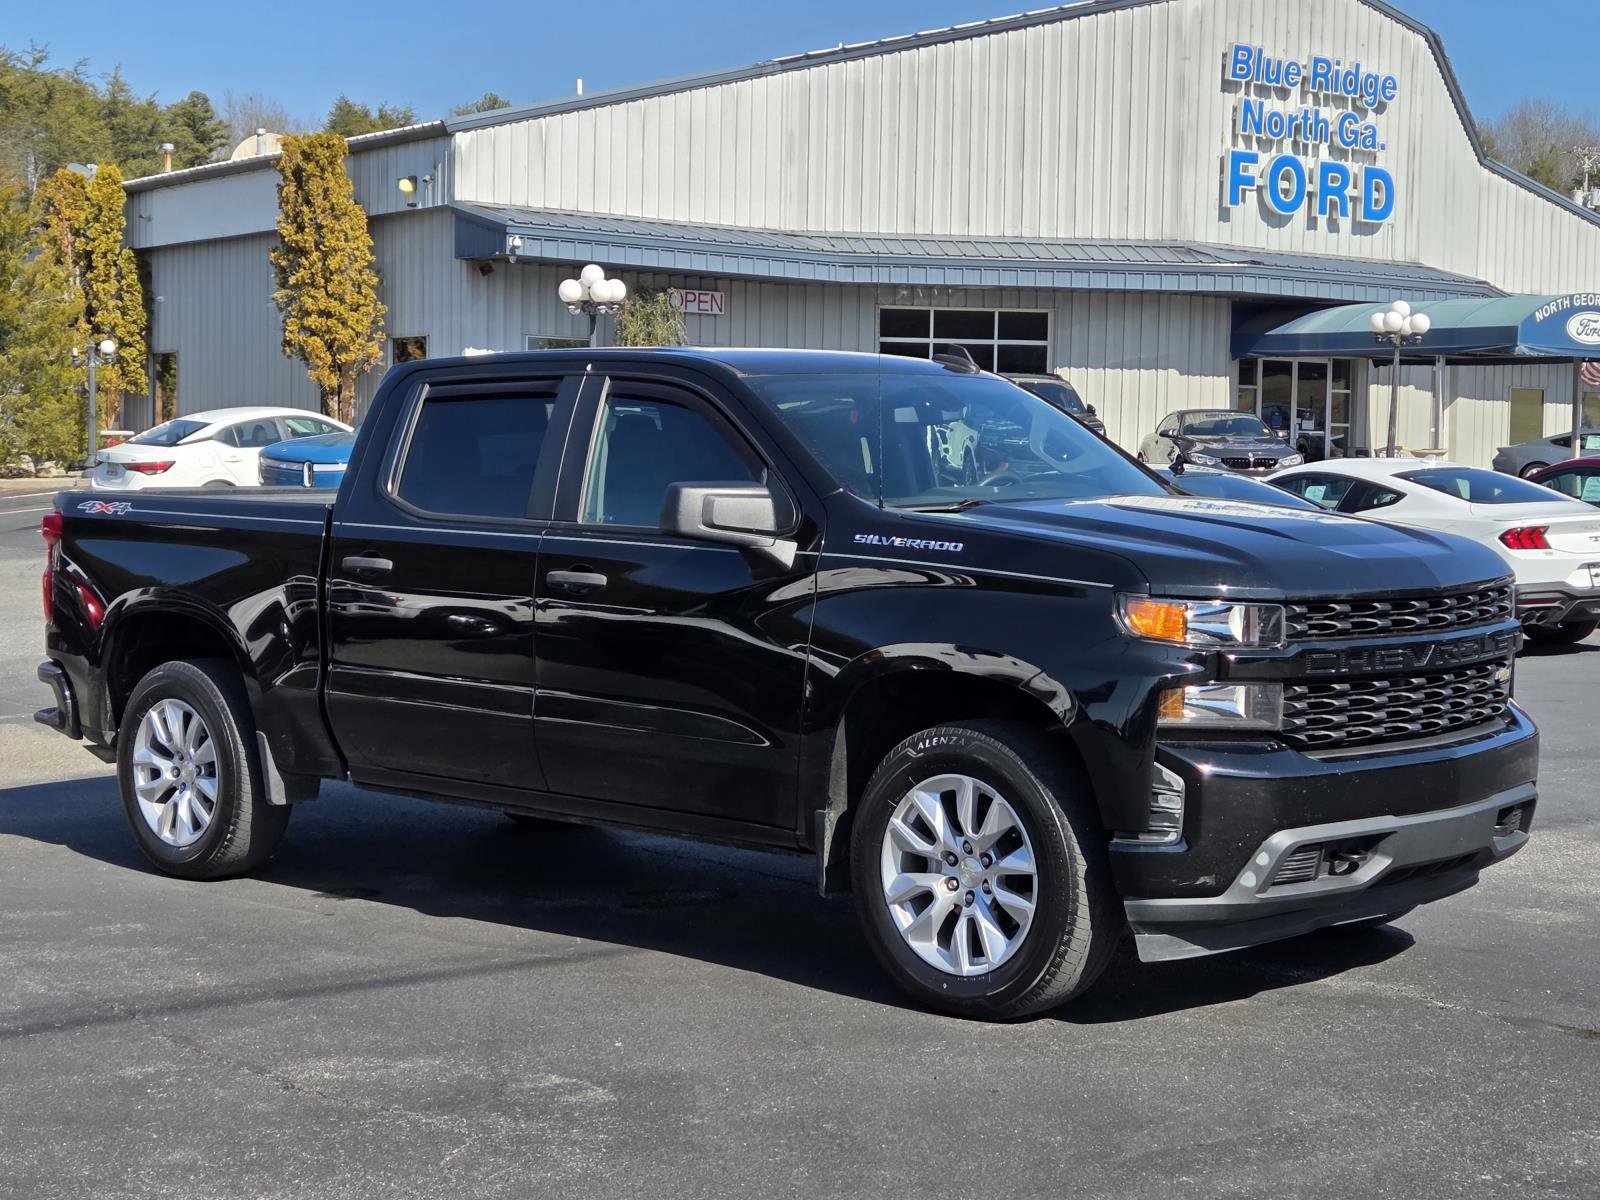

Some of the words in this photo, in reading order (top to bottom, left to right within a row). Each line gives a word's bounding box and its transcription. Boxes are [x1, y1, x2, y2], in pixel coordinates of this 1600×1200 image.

[1230, 43, 1302, 88] Blue
[1310, 56, 1398, 109] Ridge
[1240, 97, 1331, 144] North
[1337, 111, 1386, 151] Ga.
[1228, 149, 1395, 223] FORD
[668, 287, 723, 313] OPEN
[1535, 296, 1570, 323] NORTH
[853, 534, 964, 552] SILVERADO
[1305, 631, 1523, 675] CHEVROLET
[917, 736, 965, 750] ALENZA
